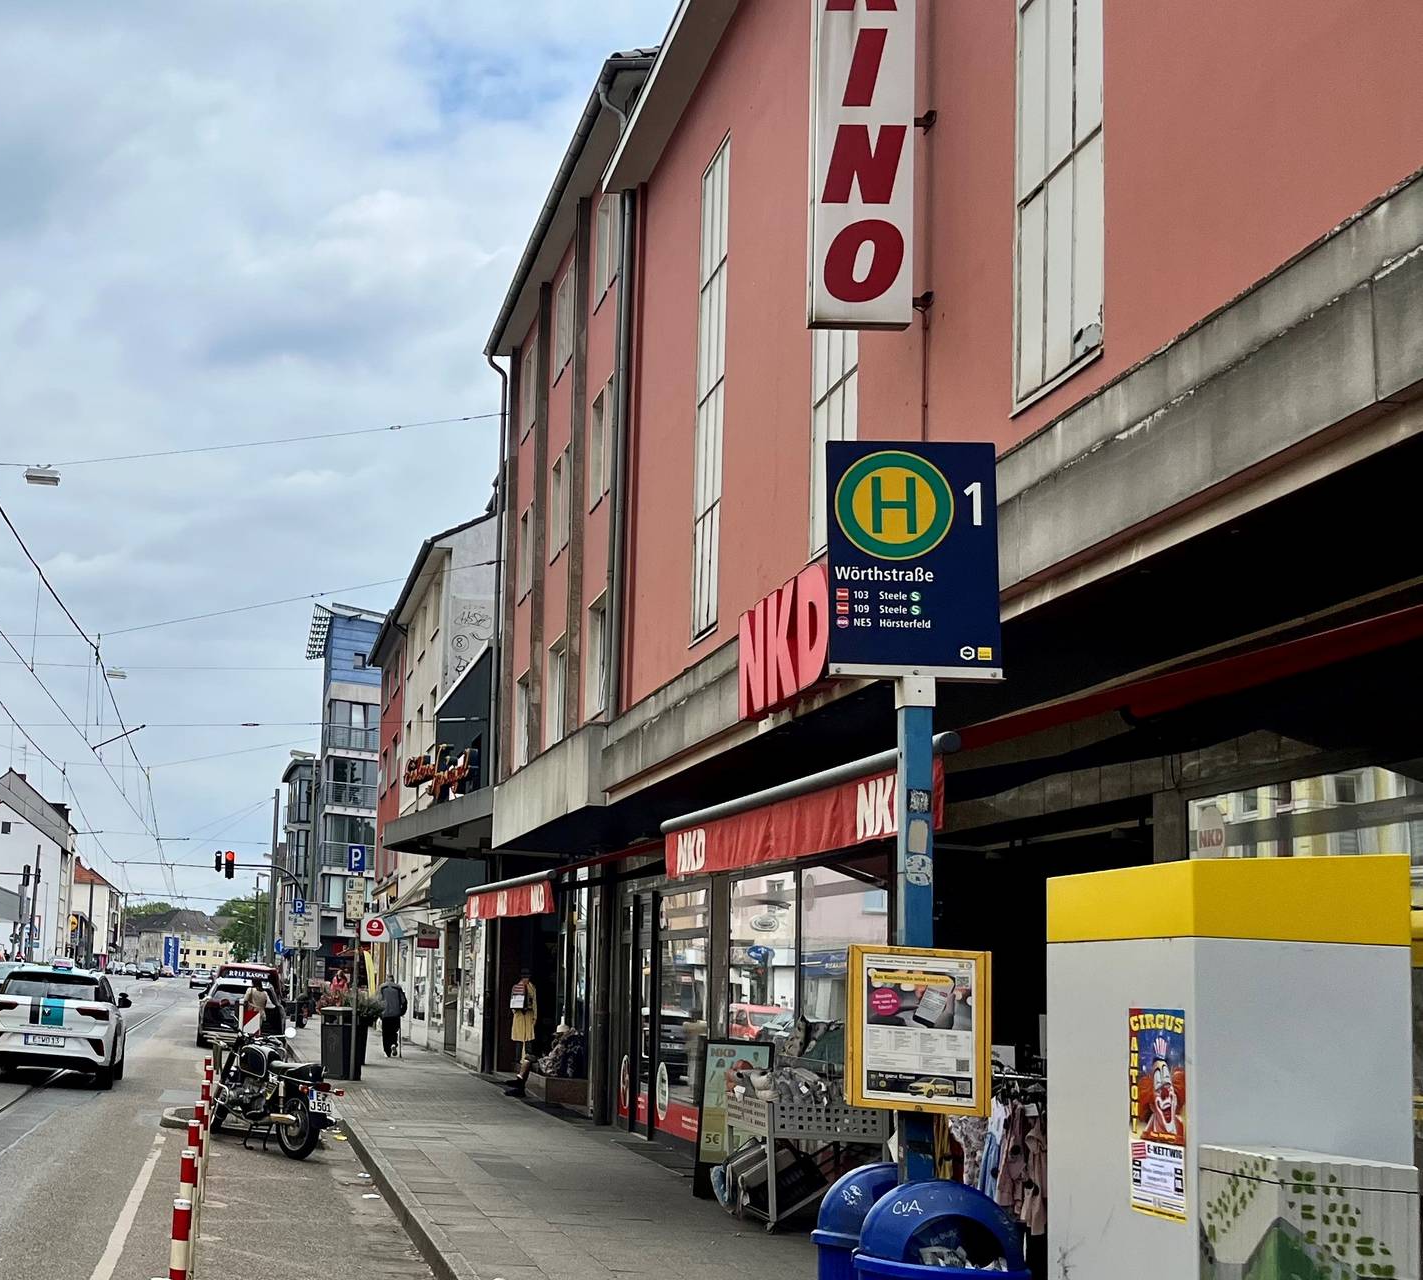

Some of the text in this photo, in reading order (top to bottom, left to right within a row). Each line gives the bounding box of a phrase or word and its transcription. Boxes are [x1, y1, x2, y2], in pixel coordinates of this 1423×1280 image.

[821, 0, 907, 302] INO
[871, 476, 917, 534] H
[963, 482, 982, 526] 1
[835, 566, 934, 582] Wörthstraße
[853, 591, 869, 600] 103
[879, 591, 908, 600] Steele
[853, 604, 870, 613] 109
[879, 605, 908, 614] Steele
[853, 618, 872, 627] NES
[879, 618, 931, 629] Hörsterfeld
[738, 564, 828, 722] NKD
[857, 774, 899, 841] NK
[1199, 828, 1223, 848] NKD
[677, 828, 706, 874] NKD
[1129, 1014, 1184, 1034] CIRCUS
[711, 1048, 737, 1058] NKD
[1129, 1036, 1139, 1134] ANTONI
[317, 1103, 332, 1112] 501
[705, 1134, 720, 1144] 5€
[1147, 1144, 1183, 1160] E-KETTWIG
